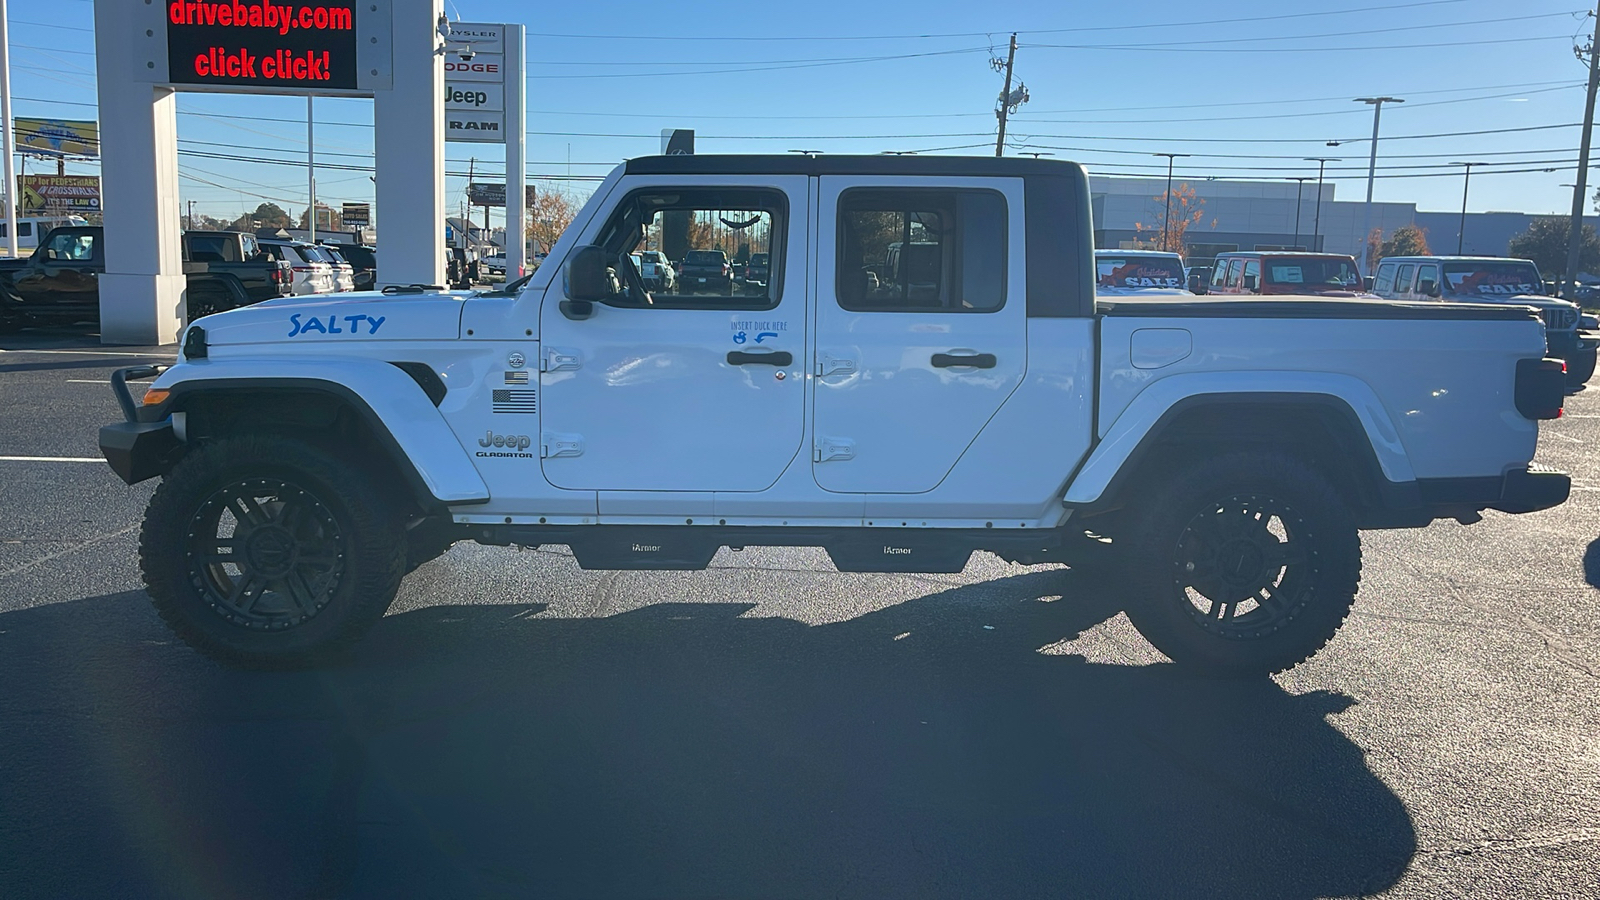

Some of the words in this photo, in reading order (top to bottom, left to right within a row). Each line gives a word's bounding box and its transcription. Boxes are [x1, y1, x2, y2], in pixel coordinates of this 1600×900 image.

[170, 0, 352, 35] drivebaby.com
[194, 46, 256, 78] click
[261, 49, 331, 81] click!
[444, 63, 498, 73] ODGE
[445, 86, 487, 107] Jeep
[449, 121, 499, 131] RAM
[50, 177, 98, 187] PEDESTRIANS
[1125, 277, 1179, 287] SALE
[1477, 283, 1534, 294] SALE
[288, 313, 386, 337] SALTY
[731, 321, 753, 331] INSERT
[754, 321, 771, 331] DUCK
[772, 321, 788, 331] HERE
[478, 430, 531, 451] Jeep
[475, 451, 533, 459] GLADIATOR
[632, 543, 661, 552] iArmor
